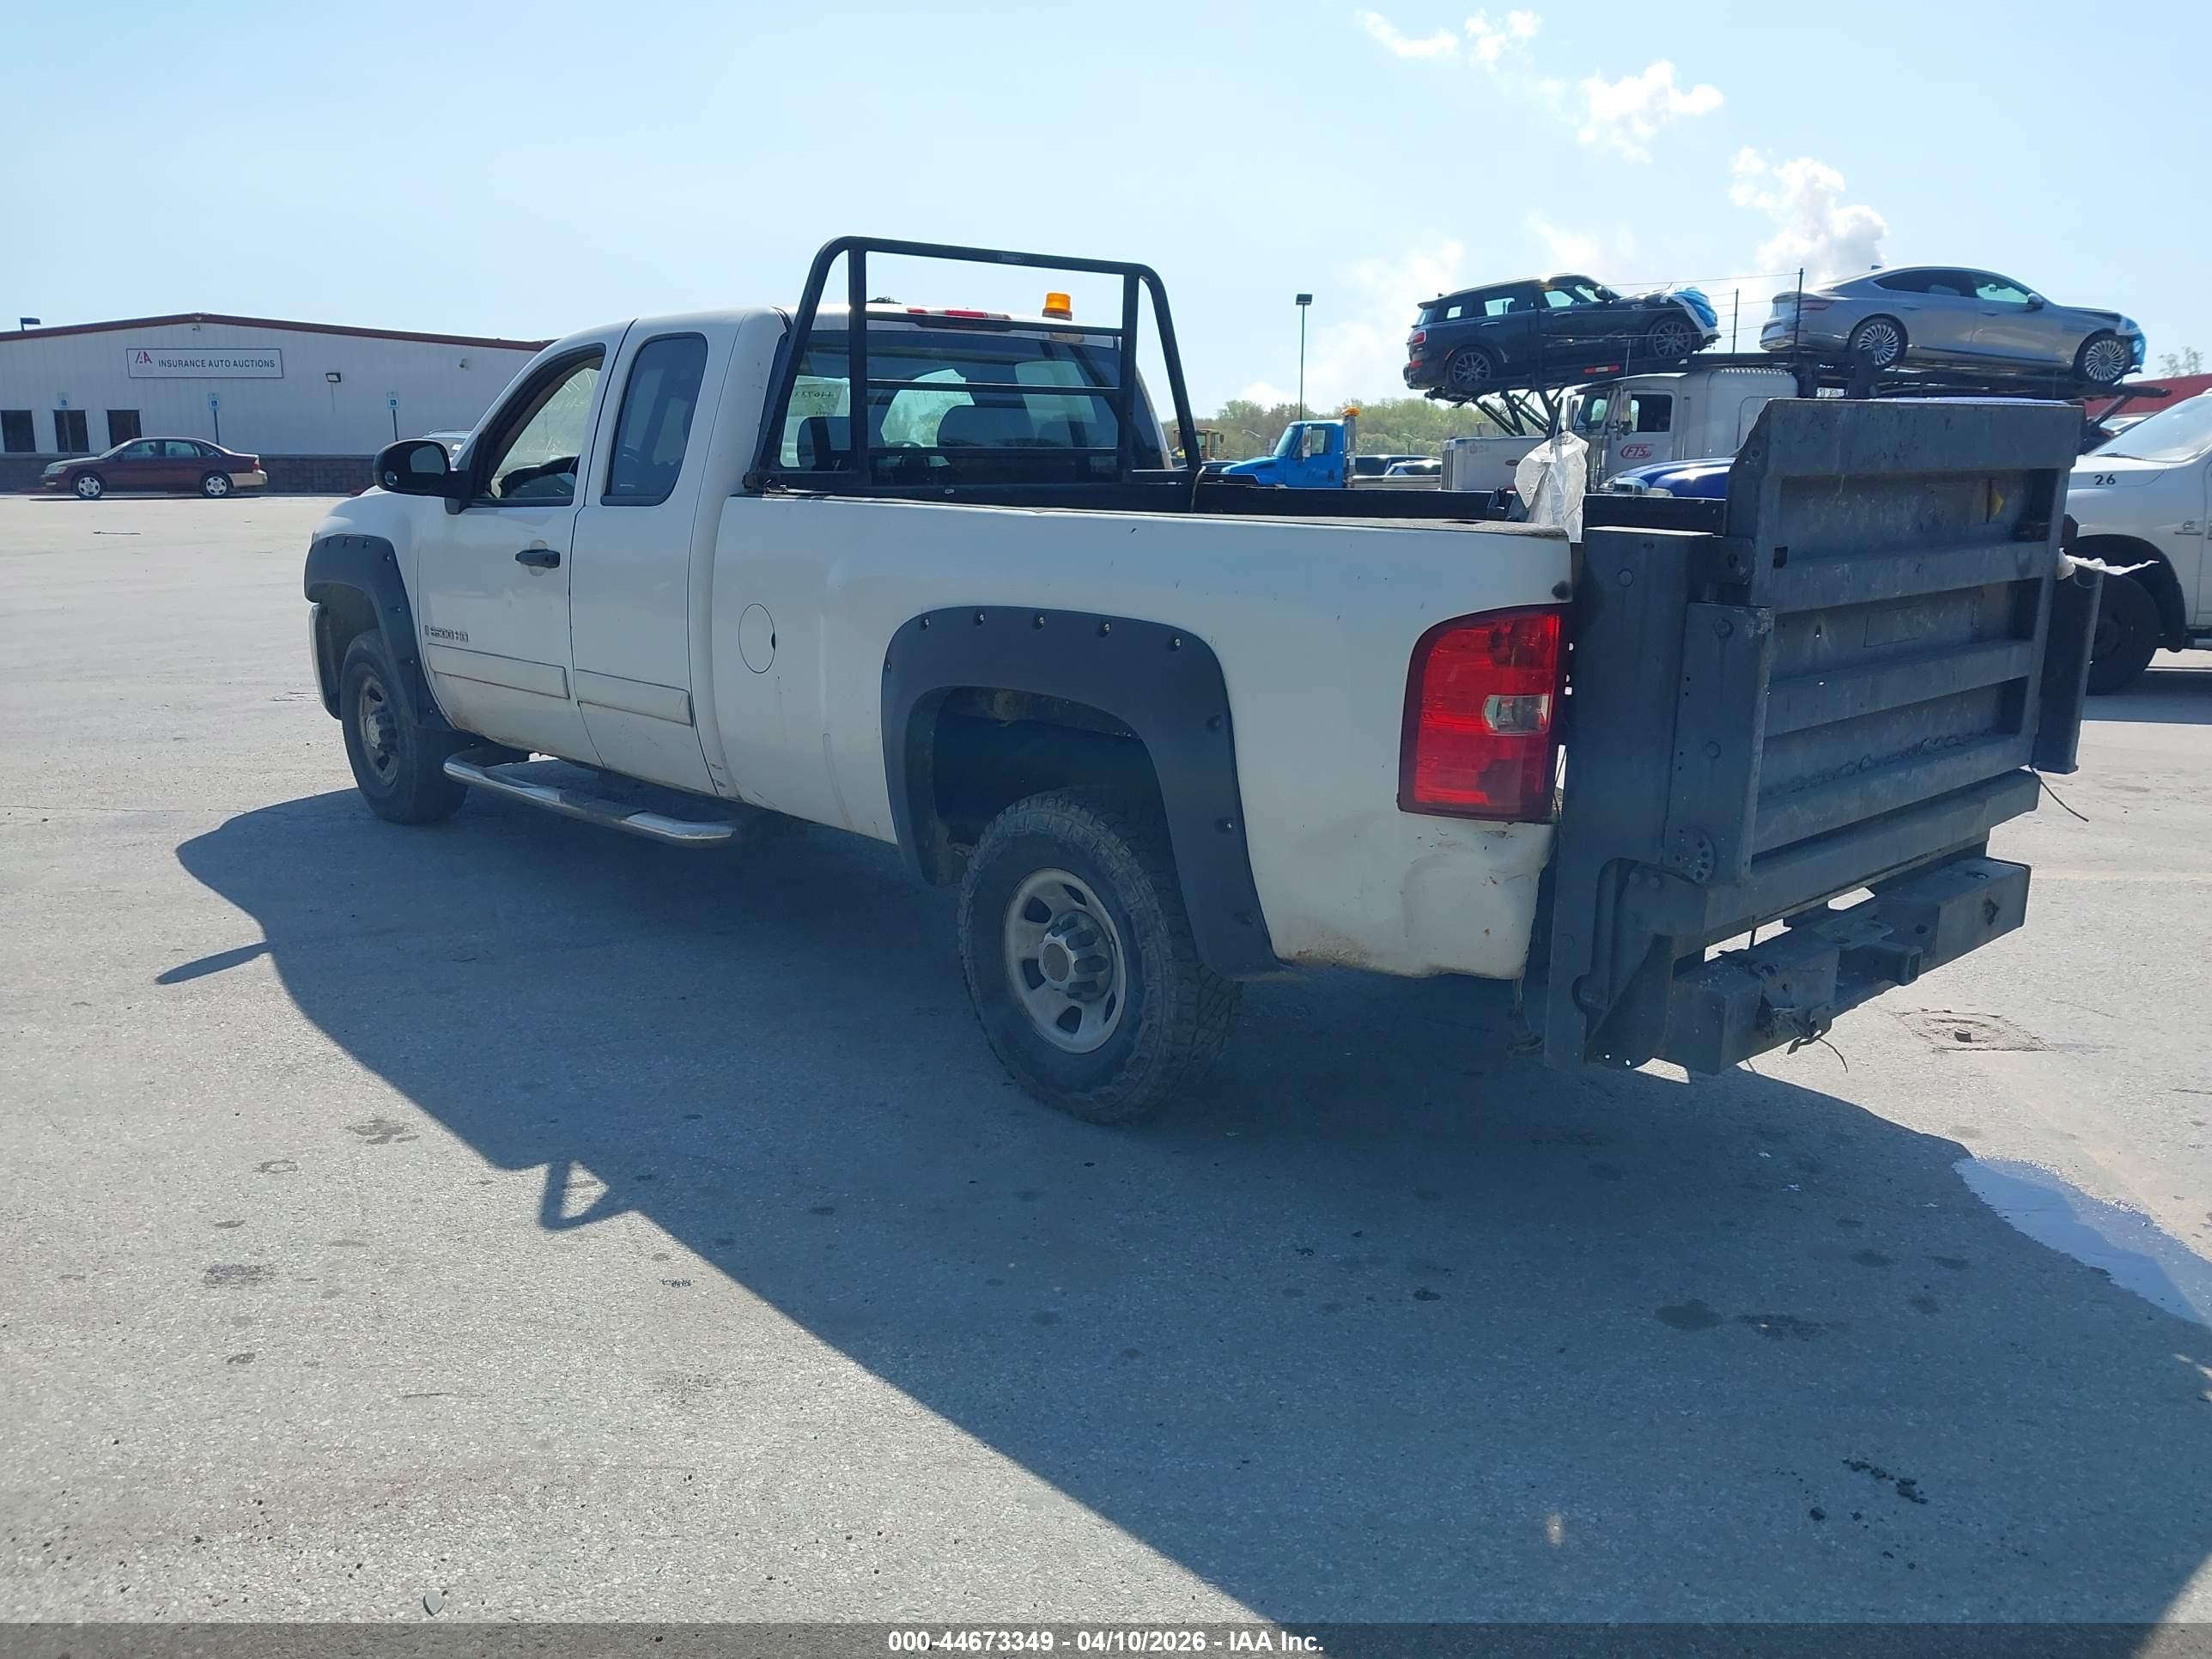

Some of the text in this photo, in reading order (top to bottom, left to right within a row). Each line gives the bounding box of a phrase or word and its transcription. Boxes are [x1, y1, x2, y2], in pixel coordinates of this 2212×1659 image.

[158, 359, 276, 368] INSURANCE AUTO AUCTIONS
[2094, 473, 2117, 486] 26
